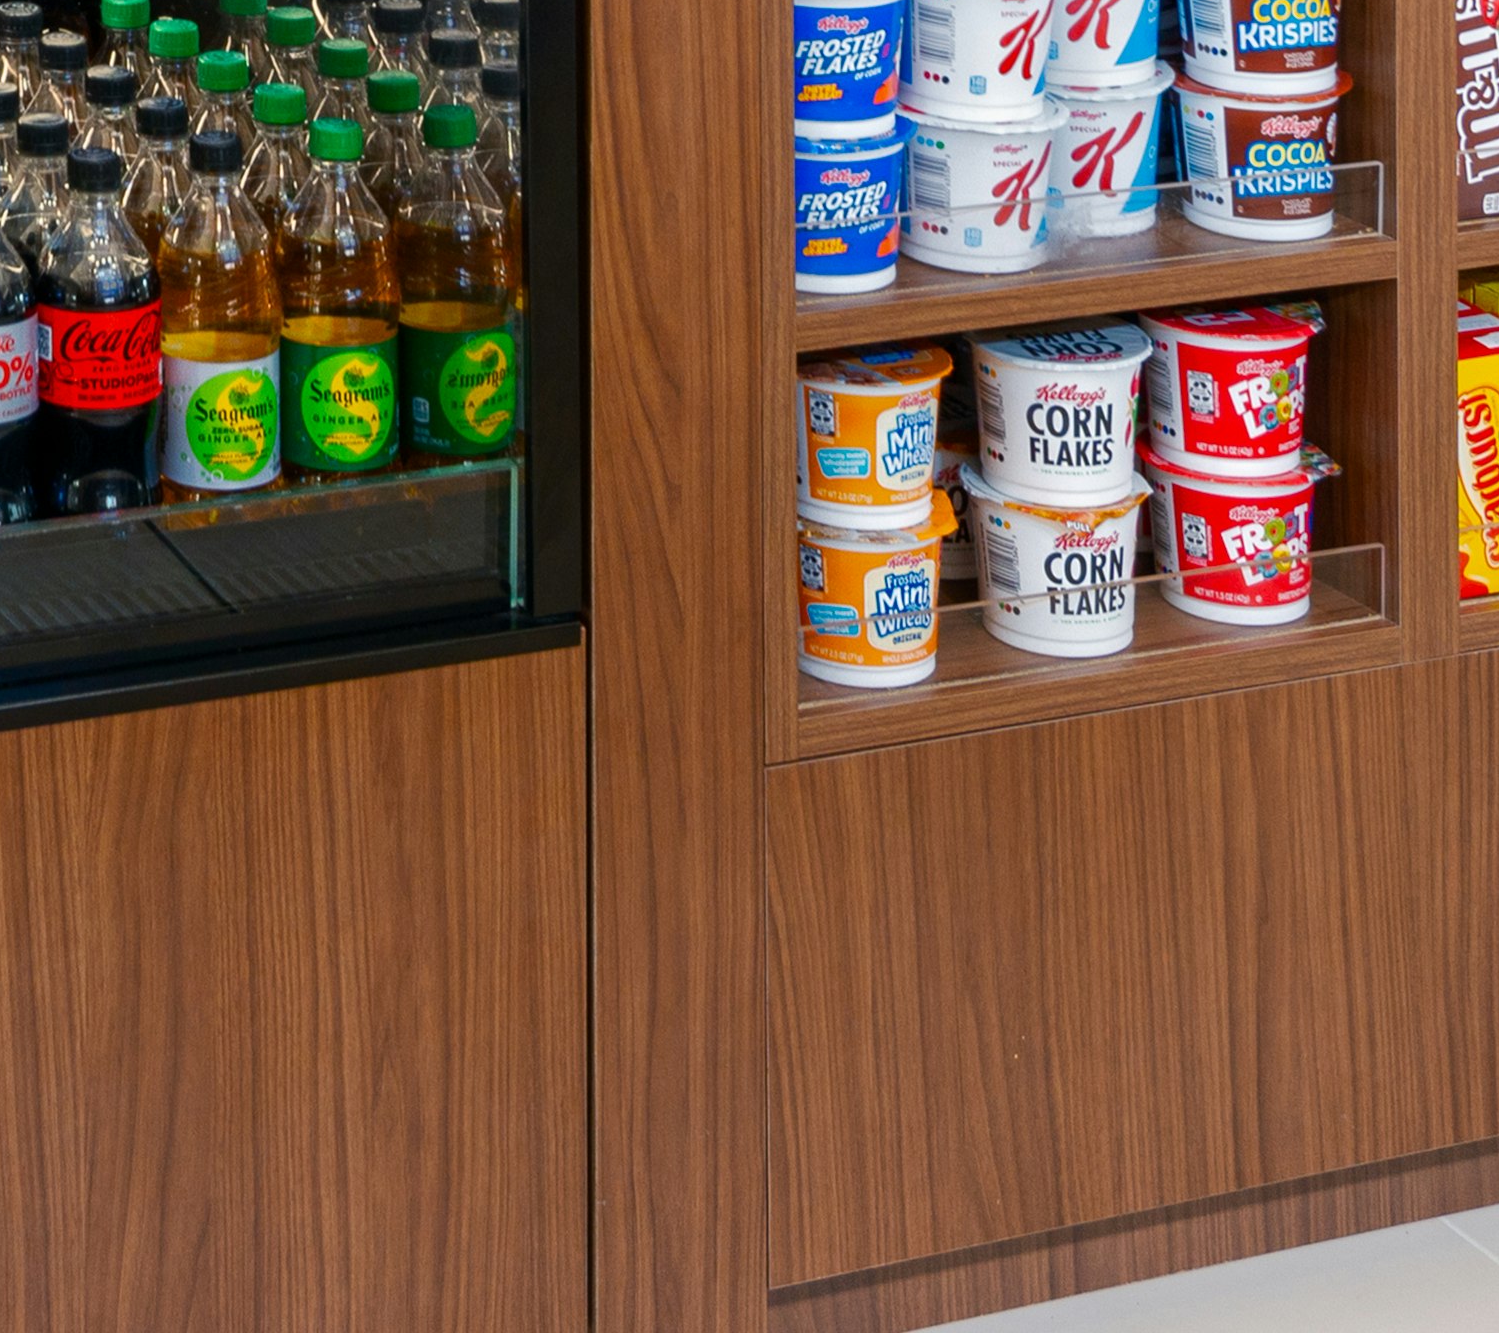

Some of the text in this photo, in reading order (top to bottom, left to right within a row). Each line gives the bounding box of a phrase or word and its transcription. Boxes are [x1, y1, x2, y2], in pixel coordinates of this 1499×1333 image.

[796, 30, 886, 60] FROSTED
[1238, 16, 1337, 51] KRISPIES
[802, 50, 879, 76] FLAKES
[1261, 116, 1321, 138] Kellogg's
[1072, 111, 1143, 196] K
[1249, 142, 1326, 167] COCOA
[1234, 163, 1333, 197] KRISPIES
[799, 181, 887, 212] FROSTED
[309, 375, 391, 406] Seagram's
[1035, 383, 1106, 406] Kellogg's
[1229, 354, 1307, 412] FROOT
[194, 395, 274, 424] Seagram's
[897, 408, 932, 429] Frosted
[1026, 403, 1113, 436] CORN
[1243, 390, 1304, 440] LOOPS
[889, 422, 934, 451] Mini
[1029, 438, 1115, 468] FLAKES
[1221, 502, 1308, 558] FROOT
[886, 571, 925, 588] Frosted
[1044, 546, 1124, 585] CORN
[879, 583, 930, 610] Mini
[1047, 584, 1125, 616] FLAKES
